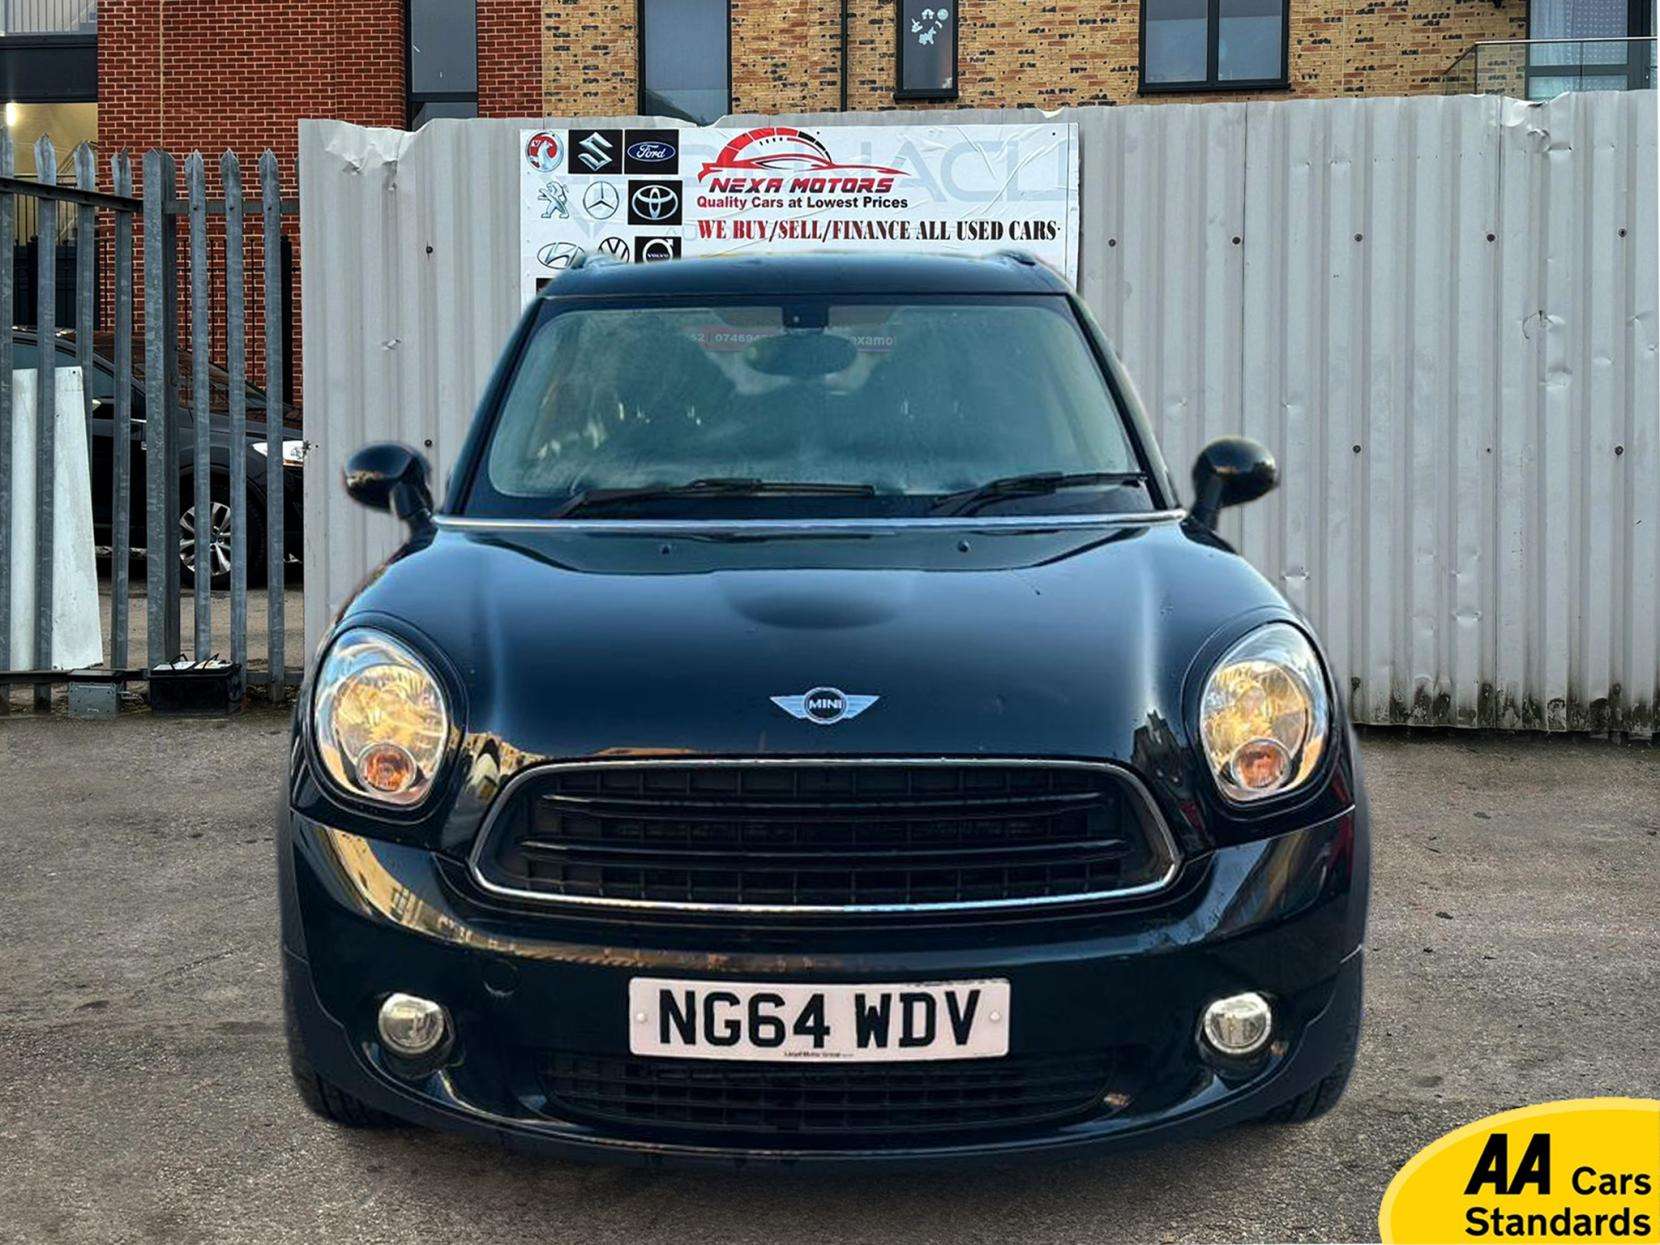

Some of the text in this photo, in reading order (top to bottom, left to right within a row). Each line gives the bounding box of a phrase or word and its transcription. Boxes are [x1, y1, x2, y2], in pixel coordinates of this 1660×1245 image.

[636, 144, 666, 159] Ford
[709, 177, 894, 193] NEXA MOTORS
[697, 196, 908, 210] Quality Cars at Lowest Prices
[697, 219, 727, 240] WE
[732, 219, 911, 242] BUY/SELL/FINANCE
[916, 220, 952, 241] ALL
[956, 220, 1003, 240] USED
[1009, 220, 1057, 240] CARS
[808, 698, 842, 709] MINI
[659, 989, 982, 1049] NG64 WDV
